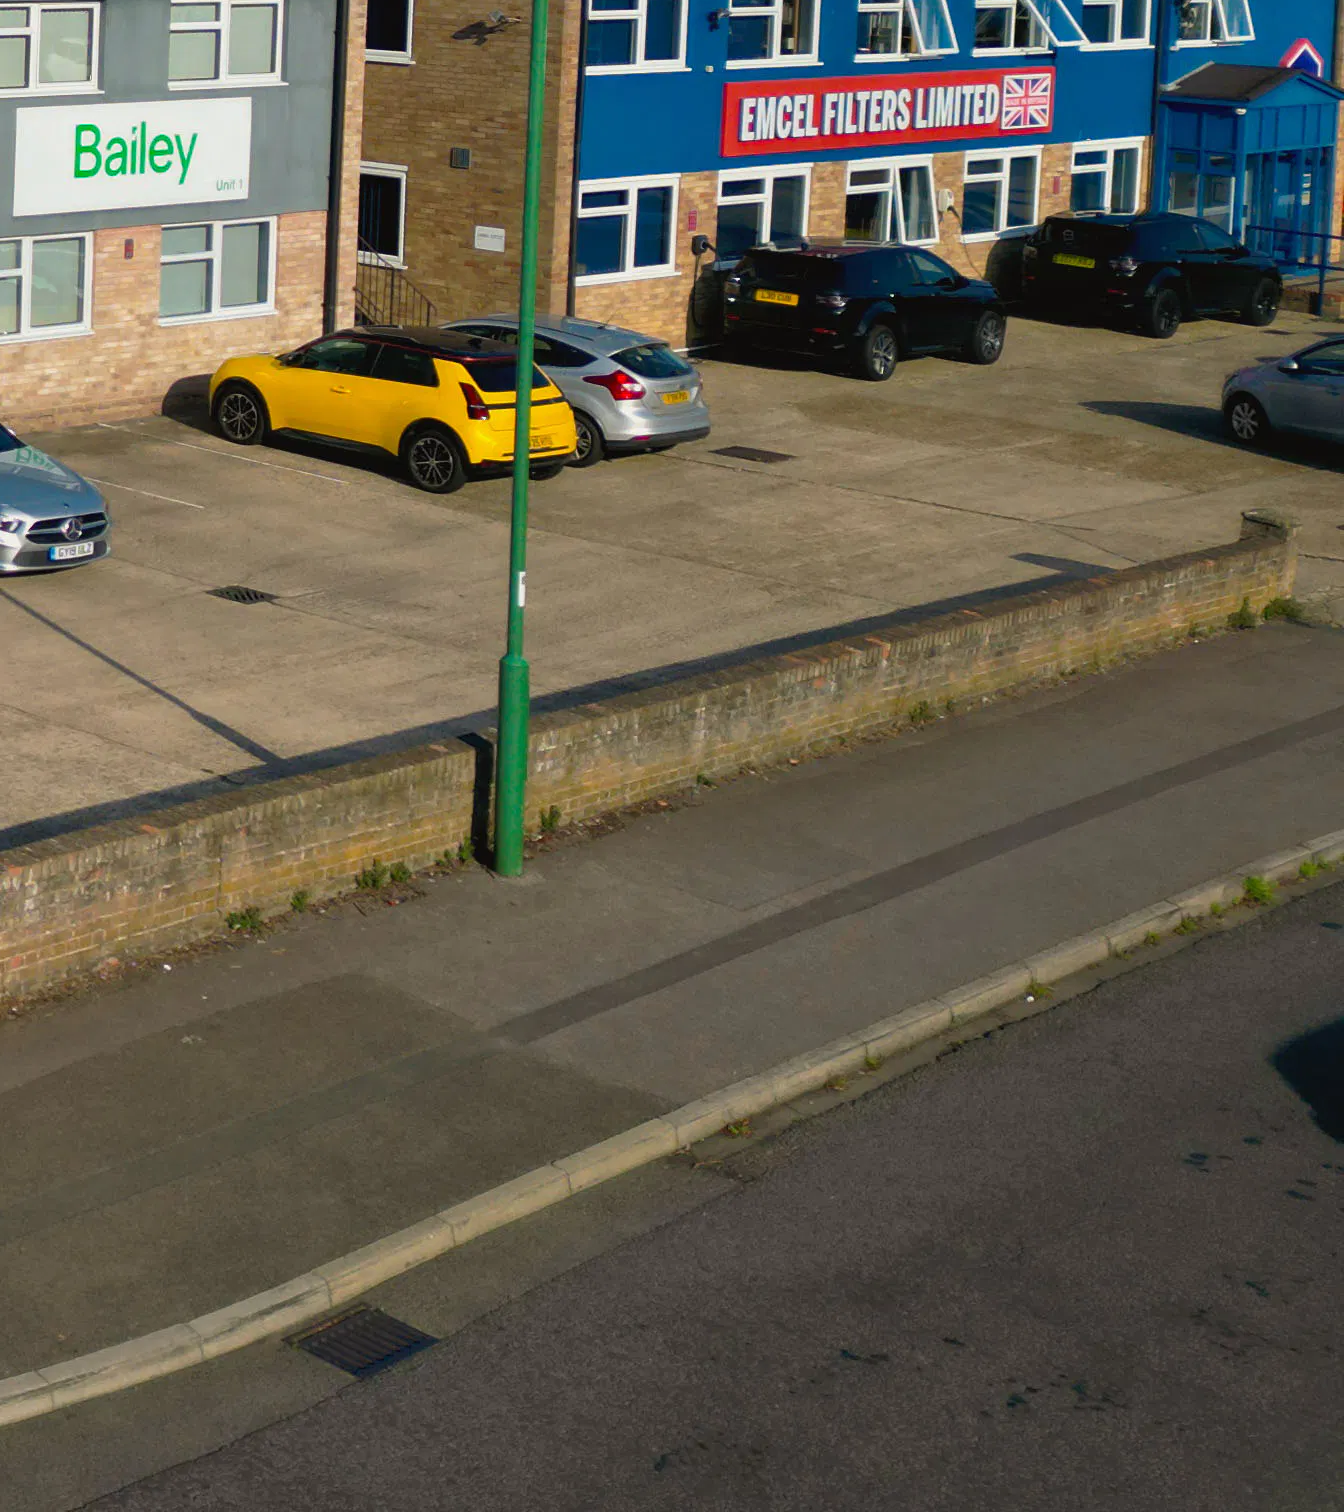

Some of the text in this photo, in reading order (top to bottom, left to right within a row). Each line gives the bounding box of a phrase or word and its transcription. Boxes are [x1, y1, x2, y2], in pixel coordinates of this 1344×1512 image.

[740, 84, 1000, 141] EMCEL FILTERS LIMITED
[74, 121, 198, 185] Bailey
[216, 179, 235, 191] Unit
